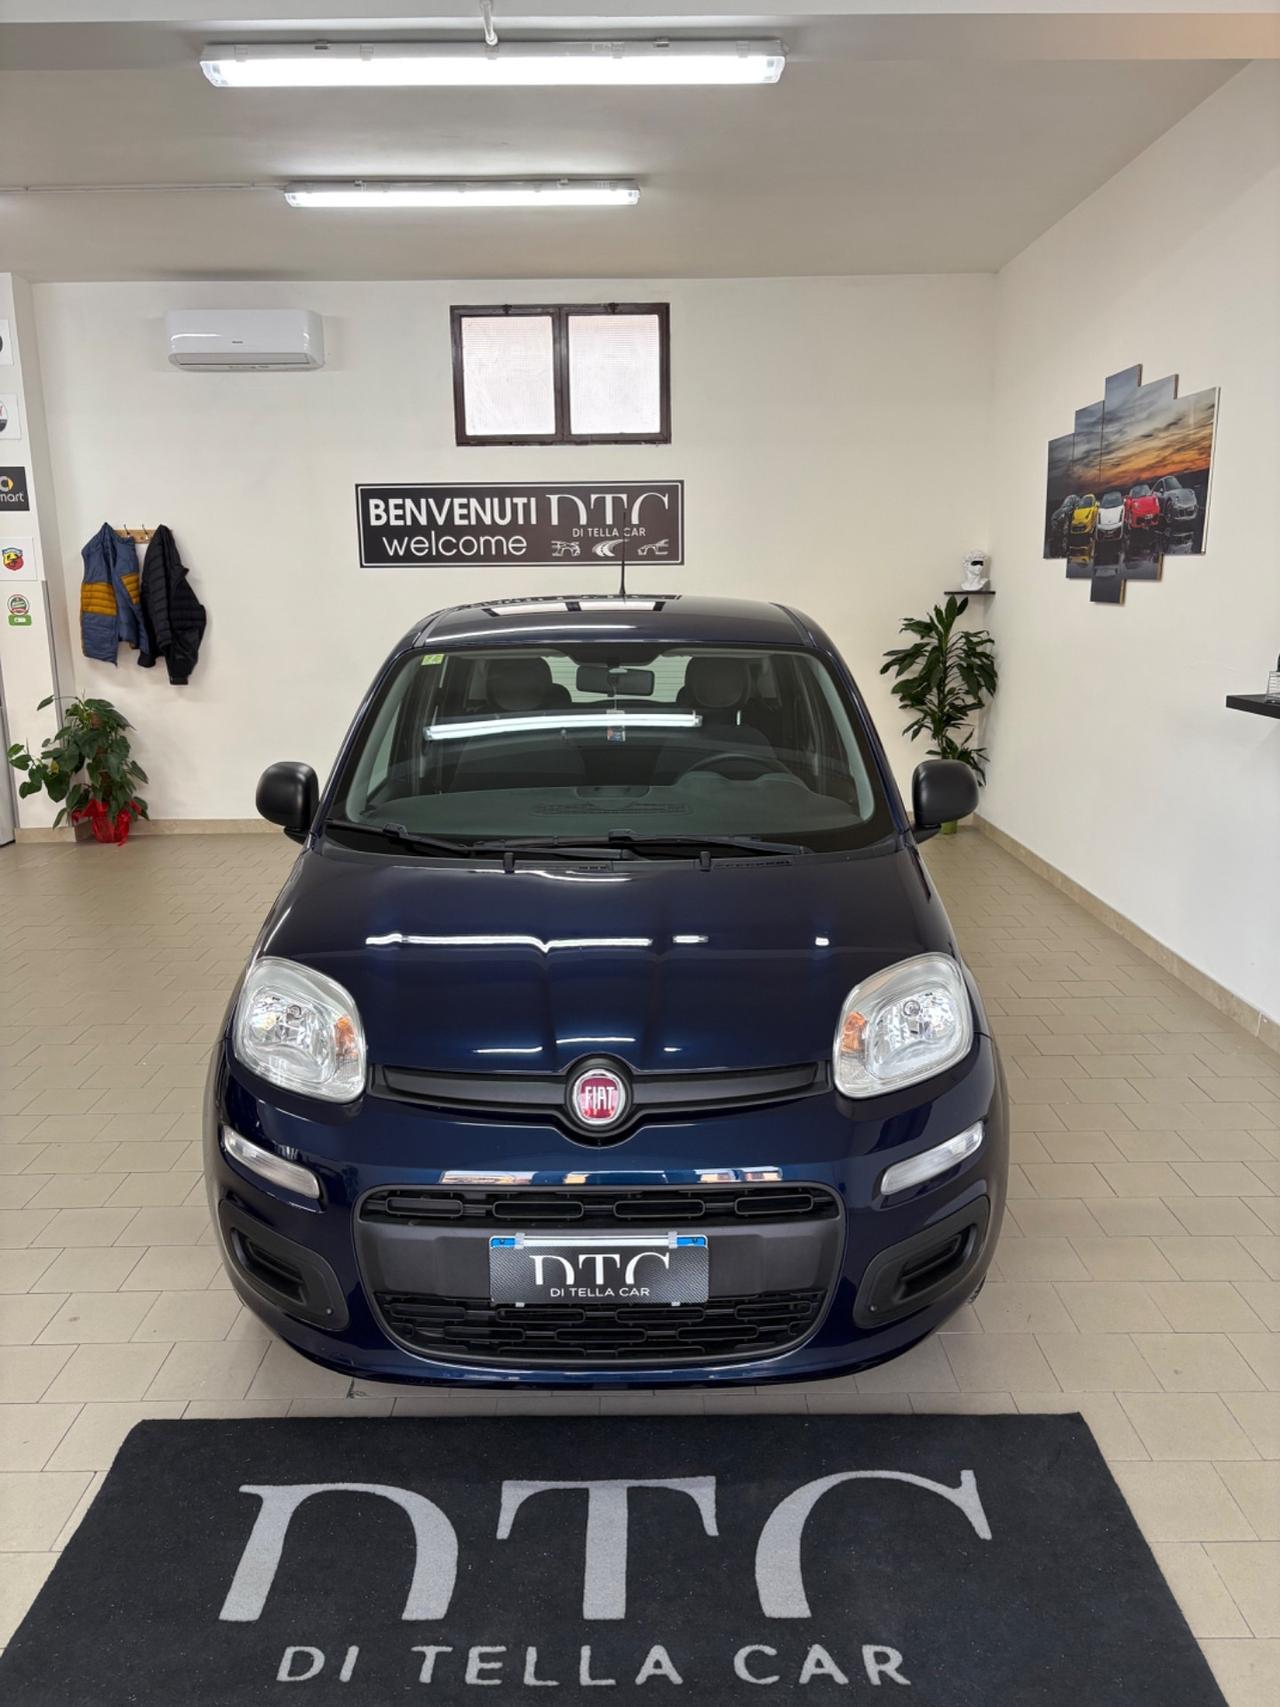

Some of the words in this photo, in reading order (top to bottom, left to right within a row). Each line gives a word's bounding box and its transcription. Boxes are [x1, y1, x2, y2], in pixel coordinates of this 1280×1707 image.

[0, 492, 24, 502] mart
[545, 492, 669, 526] DTC
[368, 497, 536, 526] BENVENUTI
[382, 530, 528, 557] welcome
[572, 527, 584, 538] DI
[586, 527, 620, 538] TELLA
[622, 526, 646, 538] CAR
[585, 1086, 615, 1110] FIAT
[528, 1251, 671, 1286] DTC
[549, 1287, 565, 1298] DI
[568, 1287, 616, 1298] TELLA
[618, 1287, 650, 1298] CAR
[219, 1470, 992, 1621] DTC
[276, 1646, 360, 1682] DI
[410, 1645, 684, 1686] TELLA
[733, 1644, 911, 1685] CAR
